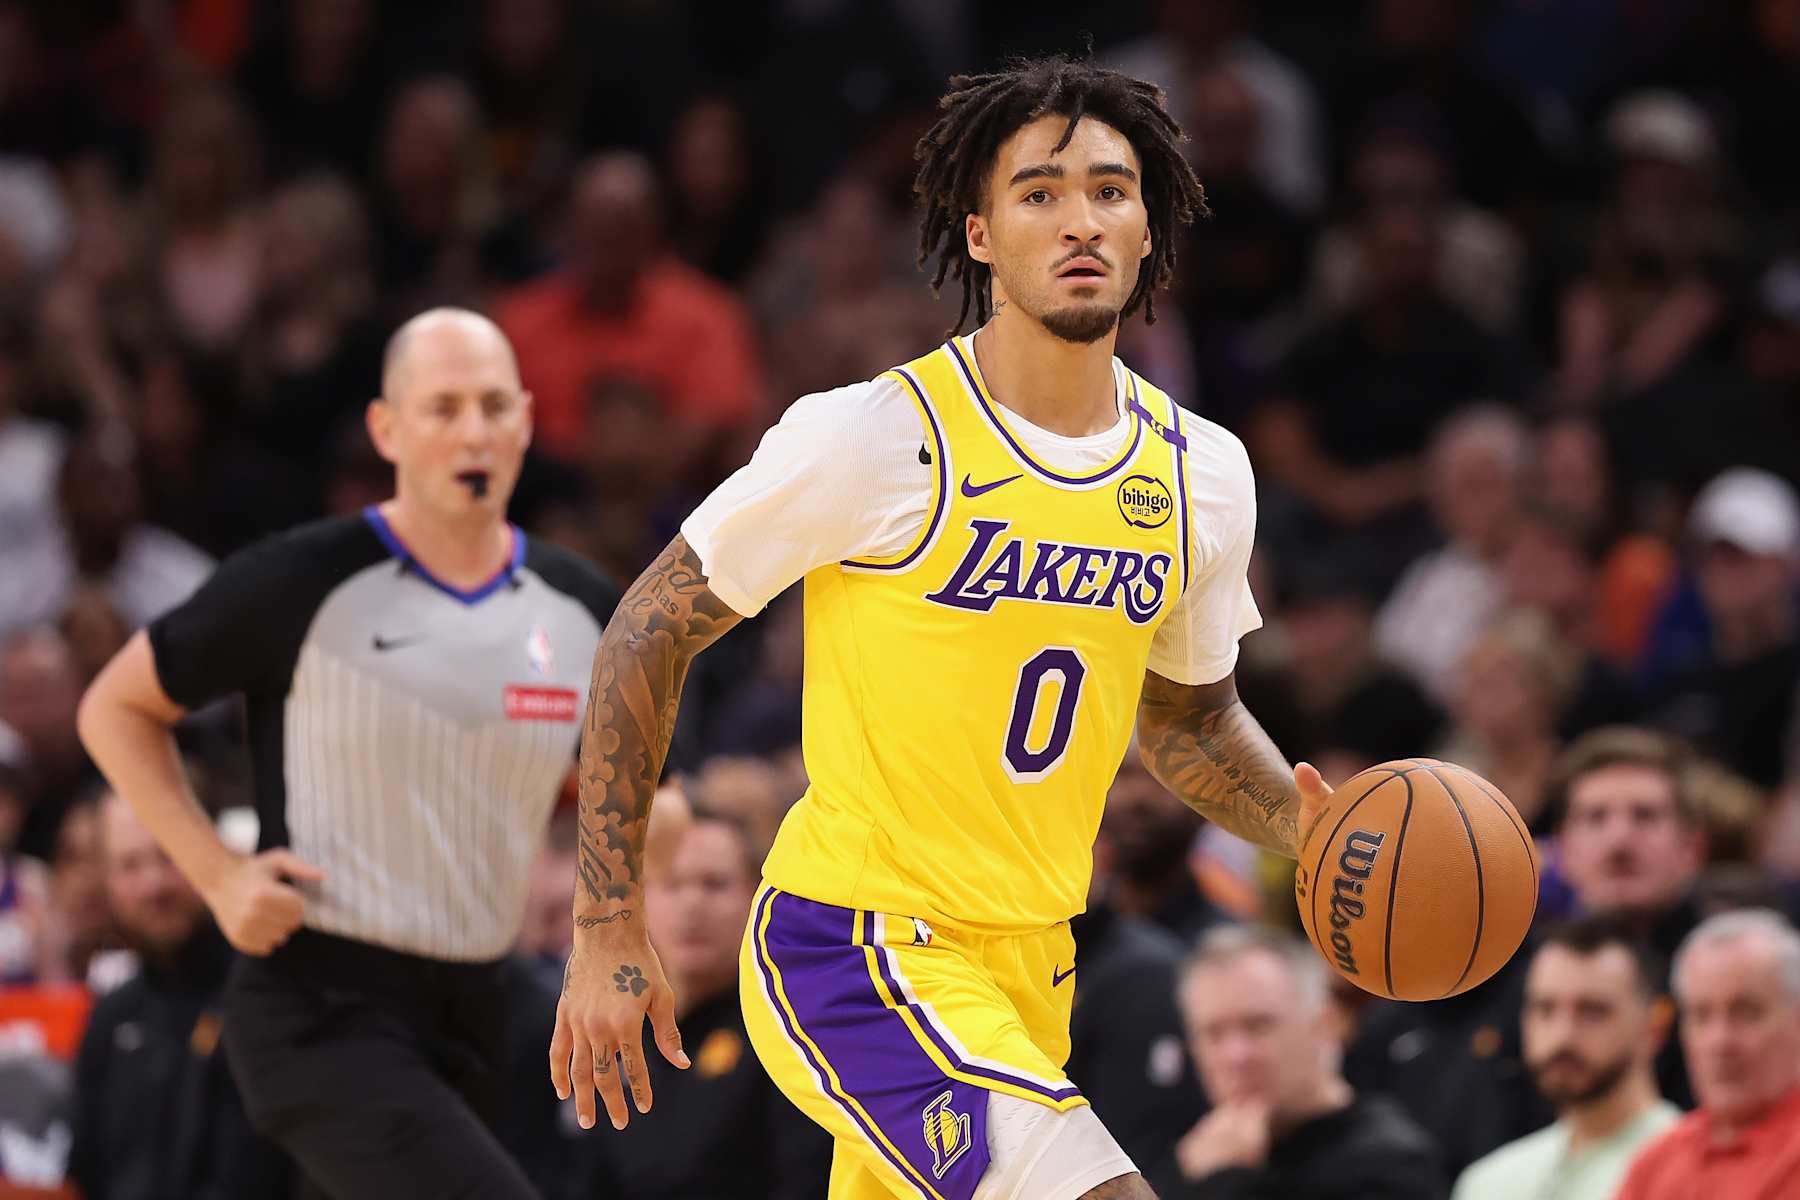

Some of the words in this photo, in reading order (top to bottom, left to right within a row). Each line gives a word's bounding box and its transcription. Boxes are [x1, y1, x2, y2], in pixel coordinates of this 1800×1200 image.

[1122, 488, 1170, 514] bibigo
[923, 518, 1173, 625] LAKERS
[1001, 646, 1087, 782] 0
[1329, 829, 1386, 976] Wilson
